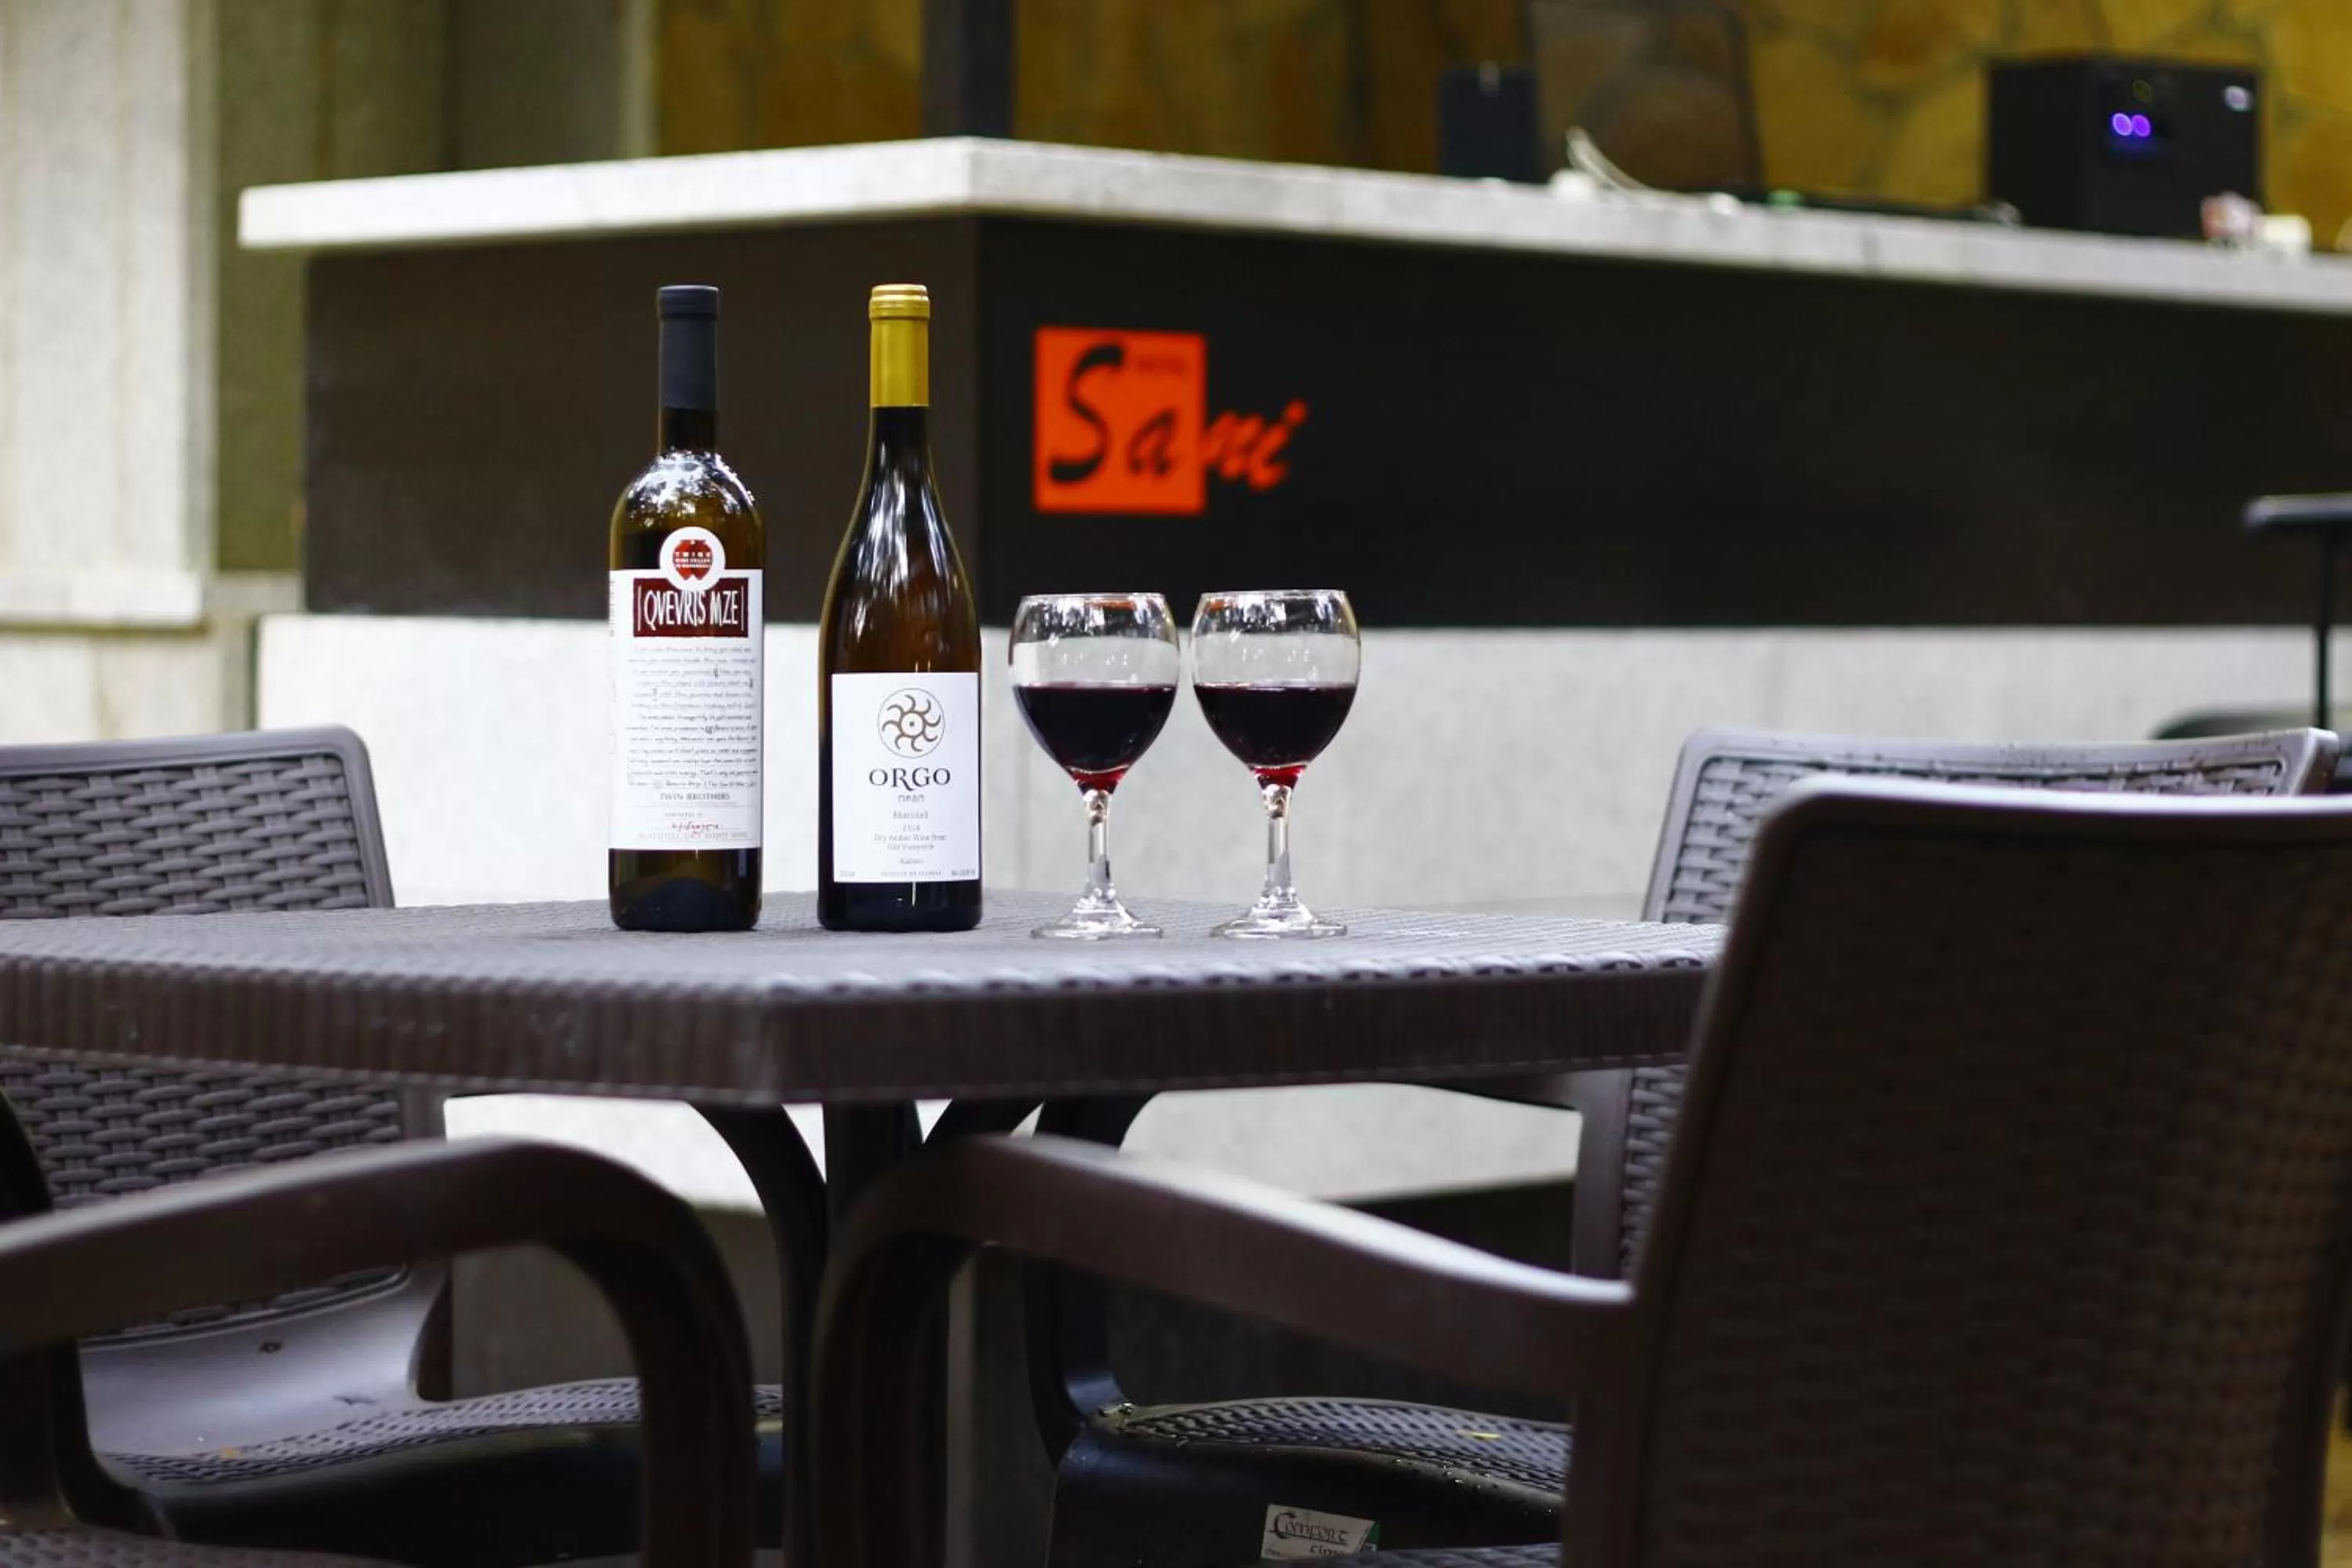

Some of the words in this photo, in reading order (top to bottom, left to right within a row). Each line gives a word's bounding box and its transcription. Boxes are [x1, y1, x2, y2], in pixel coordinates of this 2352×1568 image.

[1049, 343, 1308, 492] Sani
[644, 590, 706, 631] QVEVRIS
[710, 590, 739, 626] MZE
[869, 766, 951, 791] ORGO
